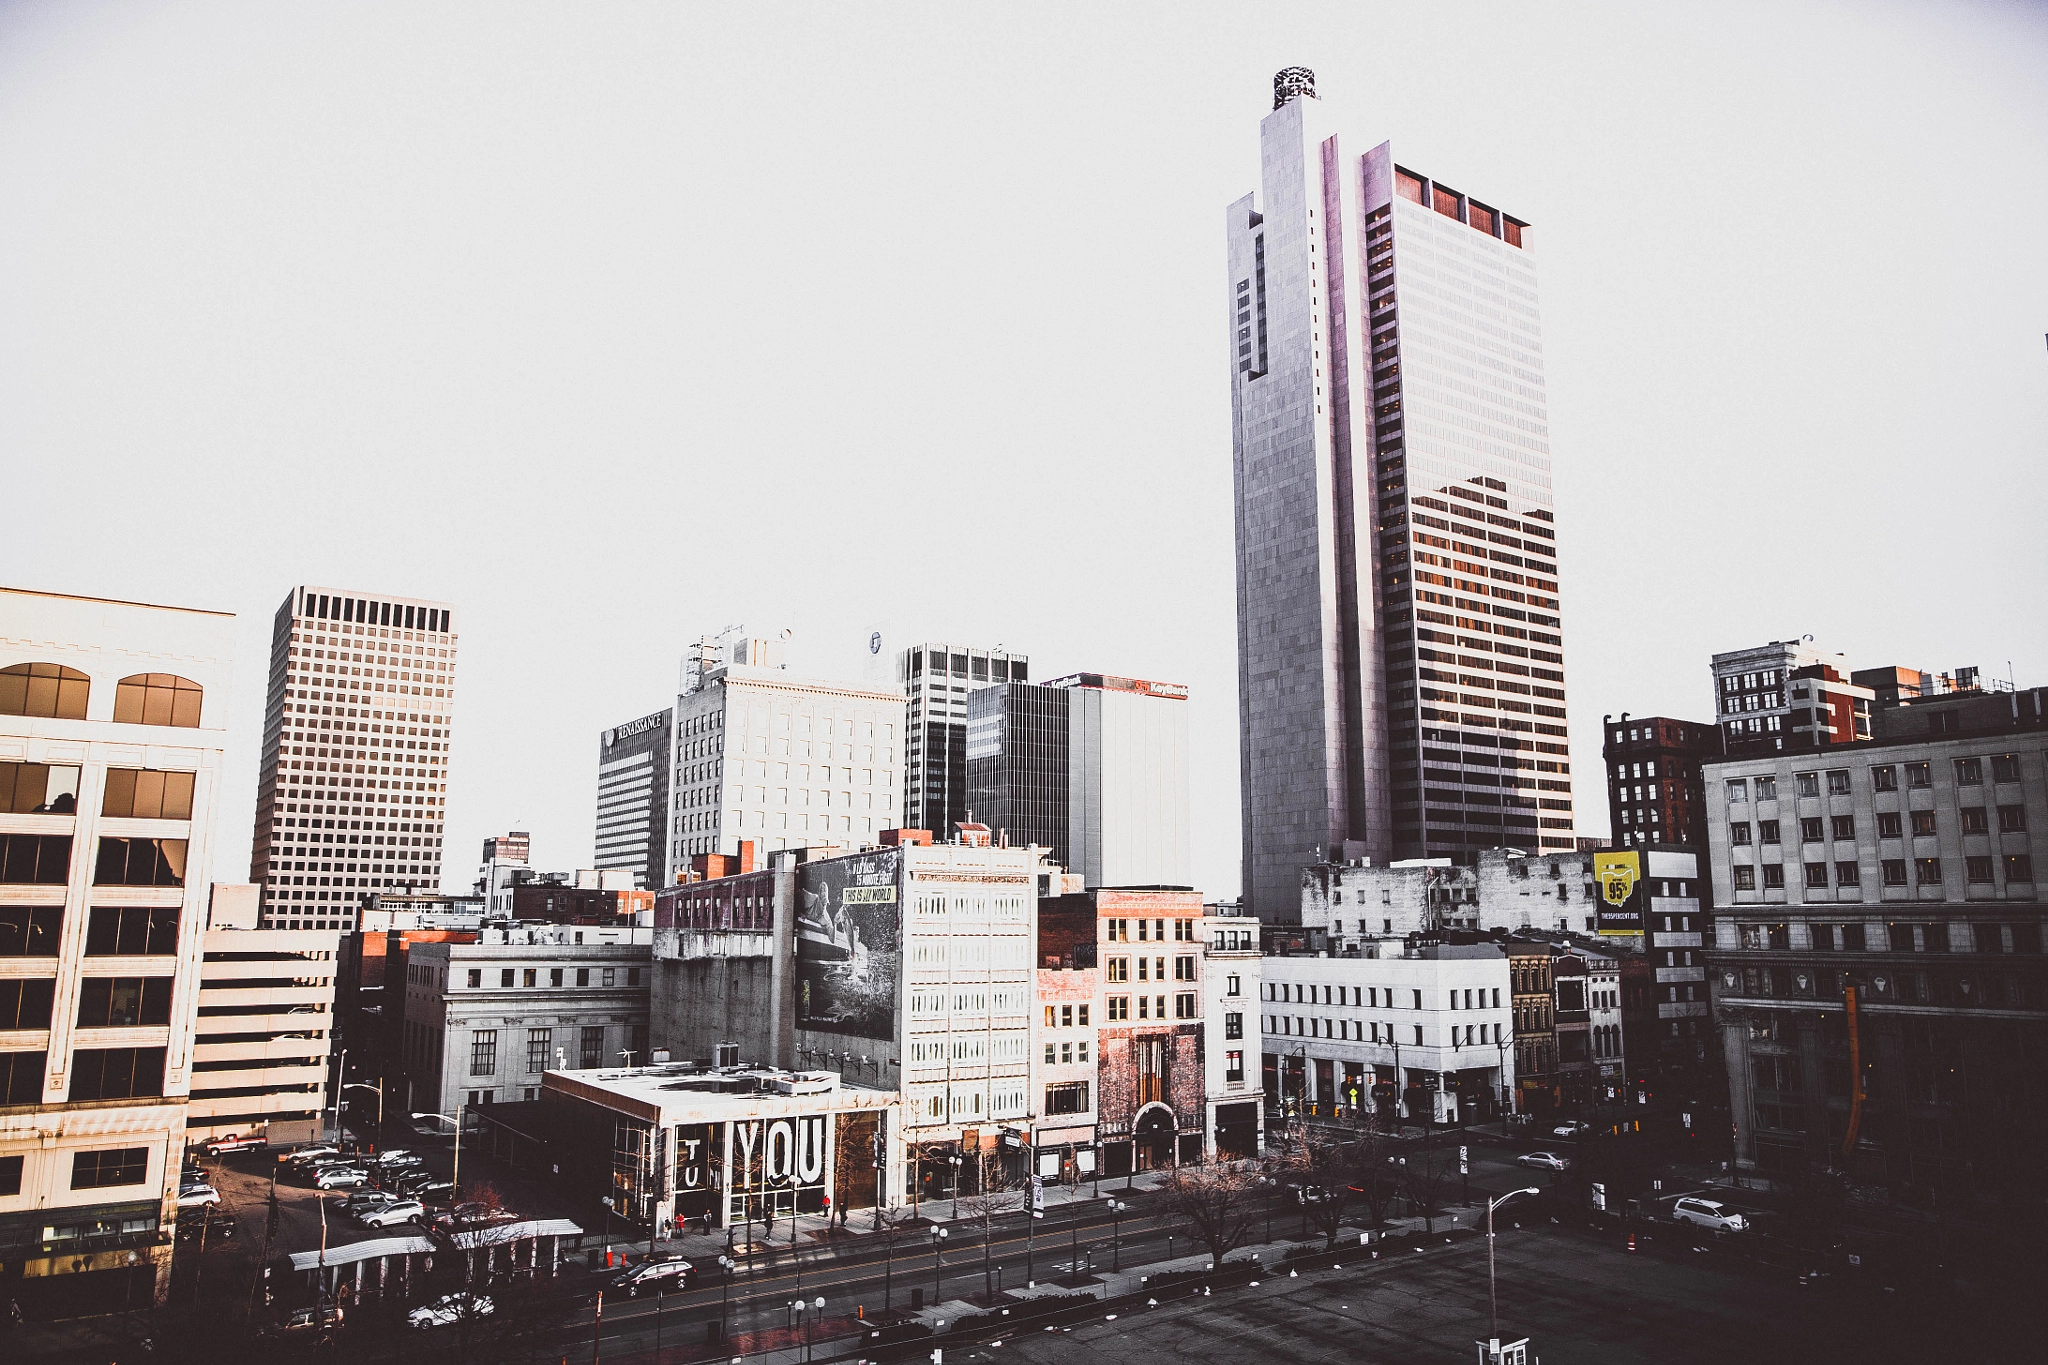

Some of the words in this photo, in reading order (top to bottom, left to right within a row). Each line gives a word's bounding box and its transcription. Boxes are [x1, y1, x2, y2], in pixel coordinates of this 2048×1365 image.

[1051, 675, 1081, 689] KeyBank
[1151, 682, 1188, 696] KeyBank
[618, 713, 662, 740] RENAISSANCE
[845, 889, 857, 902] THIS
[857, 889, 863, 902] IS
[872, 888, 892, 902] WORLD
[737, 1119, 822, 1189] YOU
